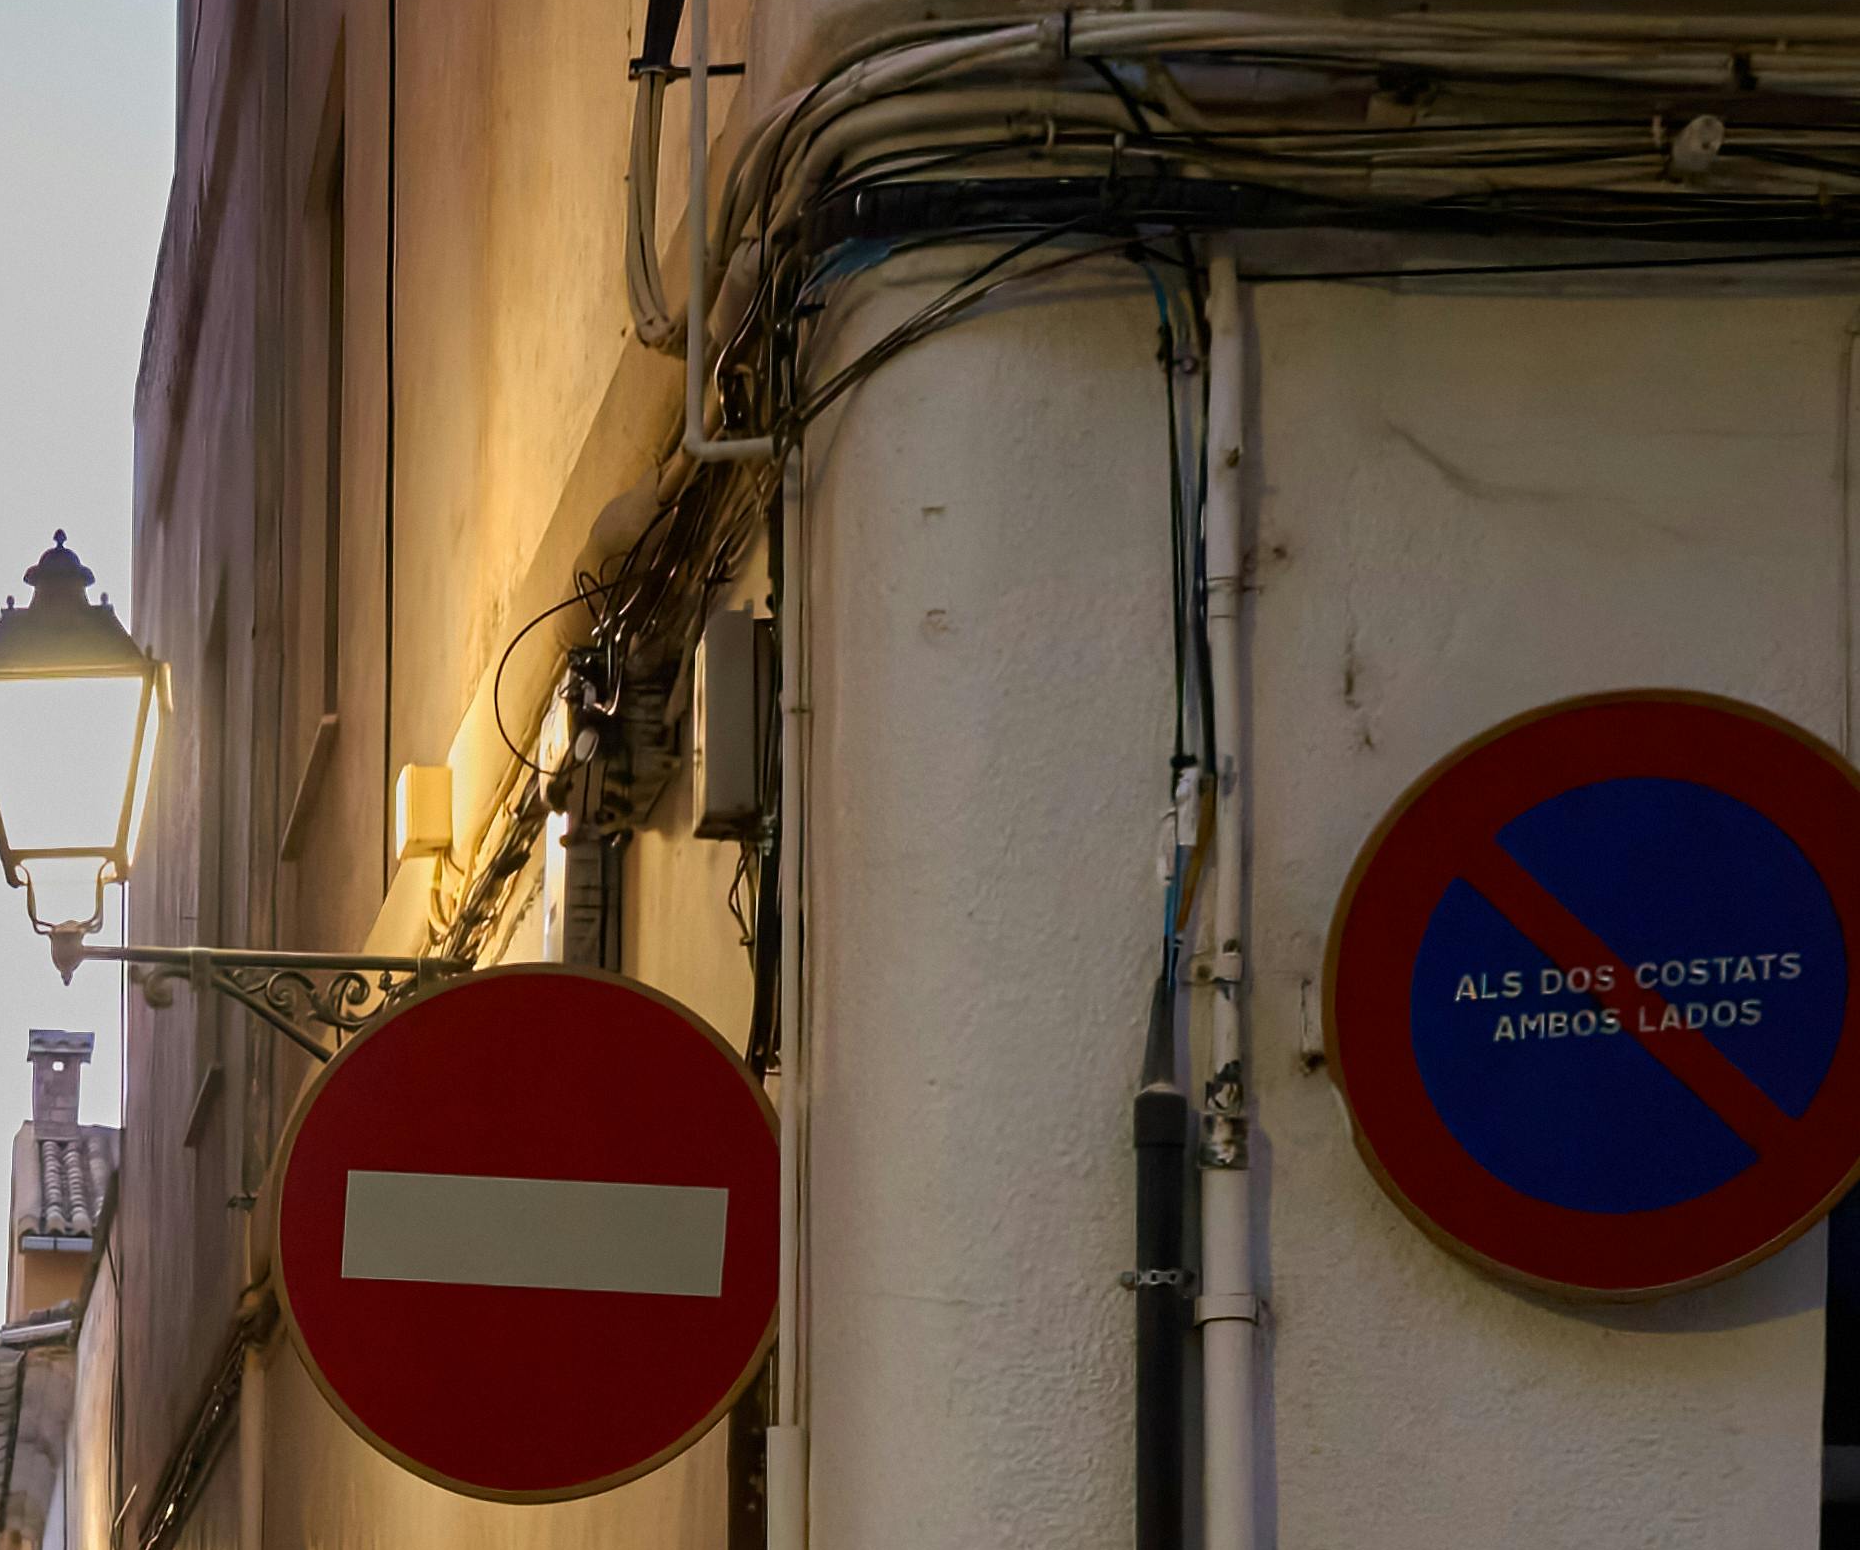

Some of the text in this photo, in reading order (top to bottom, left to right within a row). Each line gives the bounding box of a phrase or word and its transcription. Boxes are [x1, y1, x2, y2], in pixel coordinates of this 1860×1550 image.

[1455, 952, 1803, 1002] ALS DOS COSTATS
[1493, 999, 1763, 1043] AMBOS LADOS
